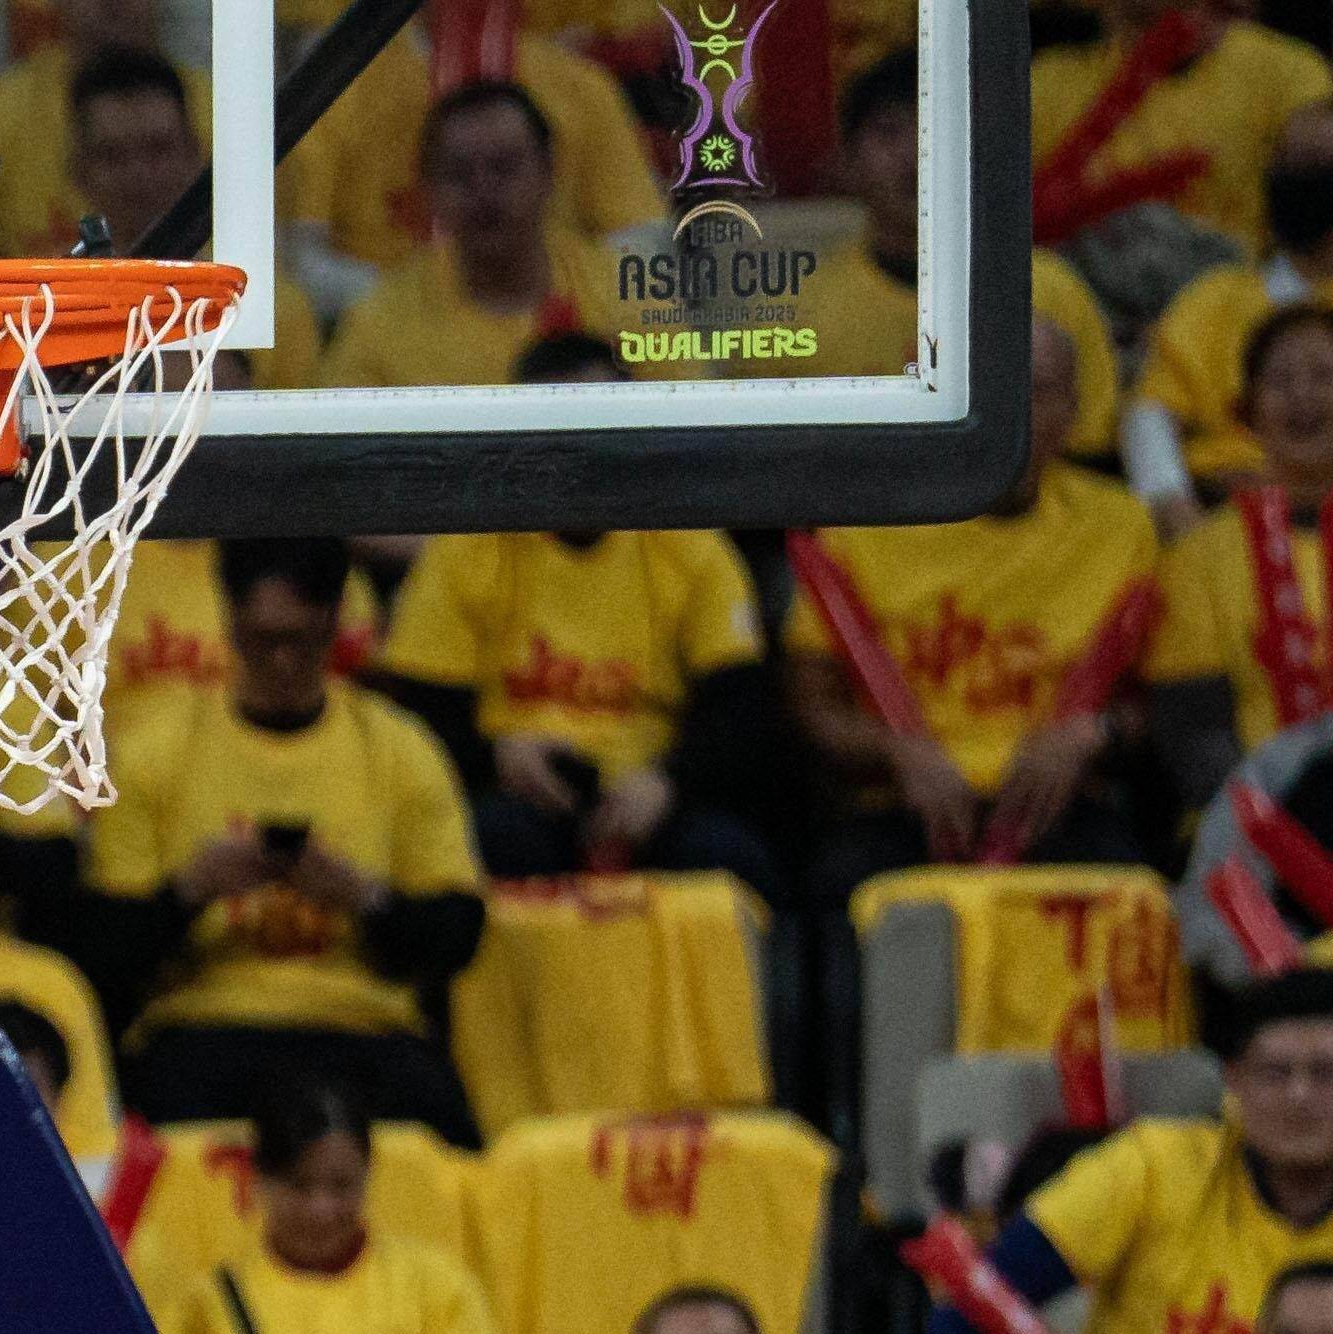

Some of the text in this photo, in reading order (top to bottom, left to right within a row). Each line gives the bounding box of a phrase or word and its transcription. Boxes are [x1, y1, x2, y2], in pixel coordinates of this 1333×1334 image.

[619, 250, 816, 300] ASIA CUP
[618, 327, 818, 363] QUALIFIERS
